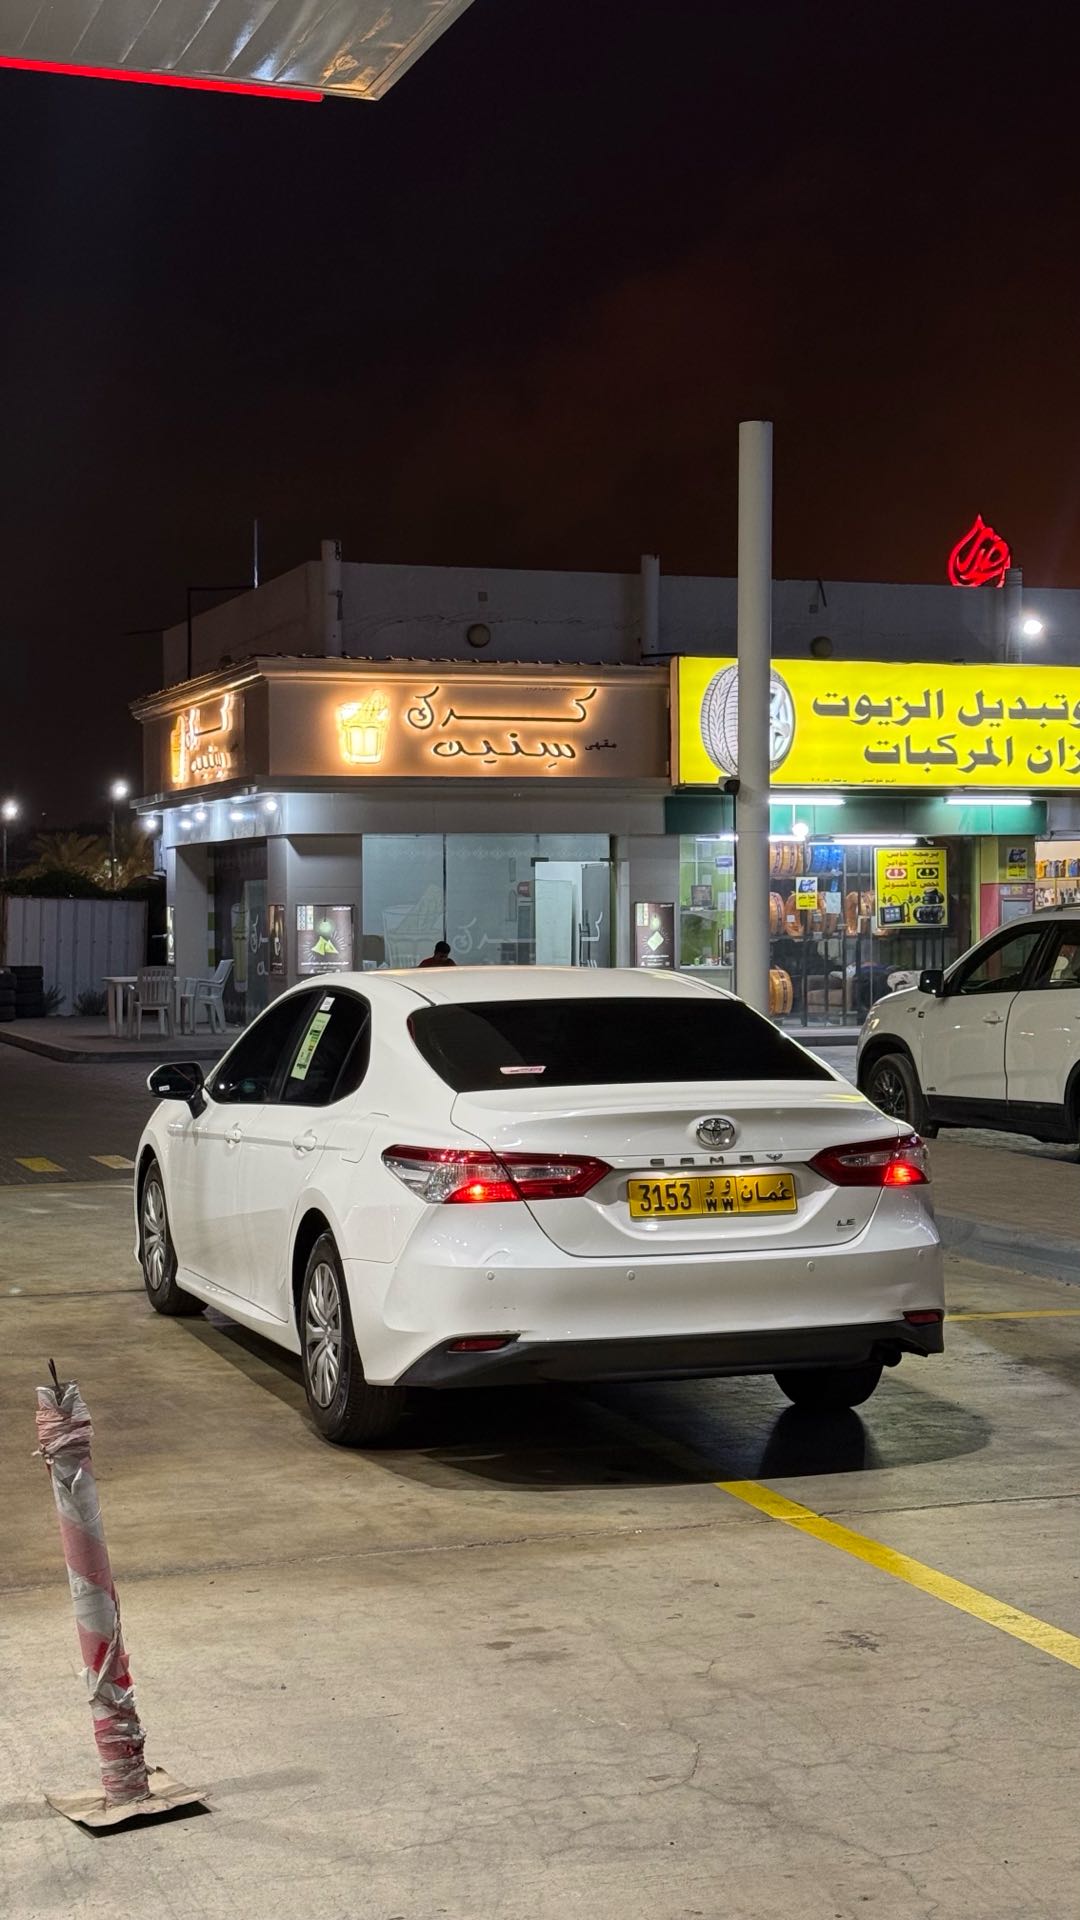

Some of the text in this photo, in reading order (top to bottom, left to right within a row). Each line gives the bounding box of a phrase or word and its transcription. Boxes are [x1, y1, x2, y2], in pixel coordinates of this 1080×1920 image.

[407, 685, 597, 730] كرك
[811, 688, 944, 727] الزيوت
[863, 733, 1014, 774] المركبات
[649, 1152, 784, 1167] CAMRY
[638, 1182, 692, 1212] 3153
[837, 1218, 856, 1227] LE
